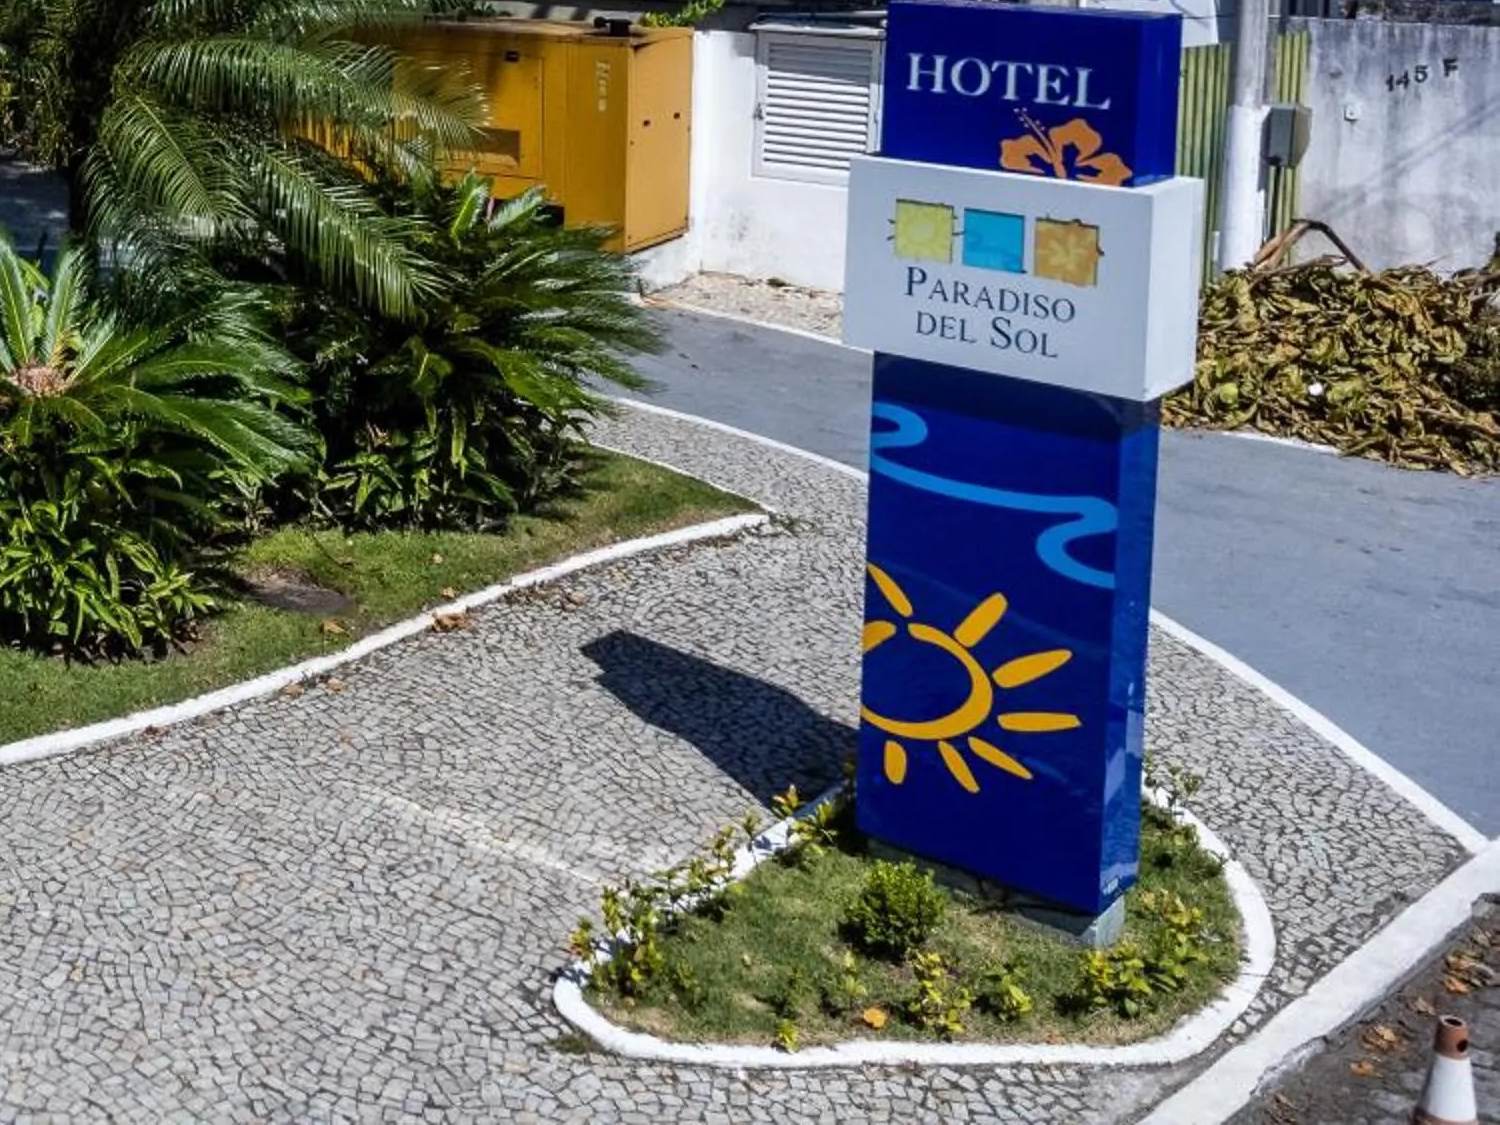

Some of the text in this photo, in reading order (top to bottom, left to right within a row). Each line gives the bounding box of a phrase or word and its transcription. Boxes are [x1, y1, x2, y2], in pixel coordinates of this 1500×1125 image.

[905, 51, 1112, 111] HOTEL
[904, 265, 1077, 324] PARADISO
[915, 310, 1059, 359] DEL SOL
